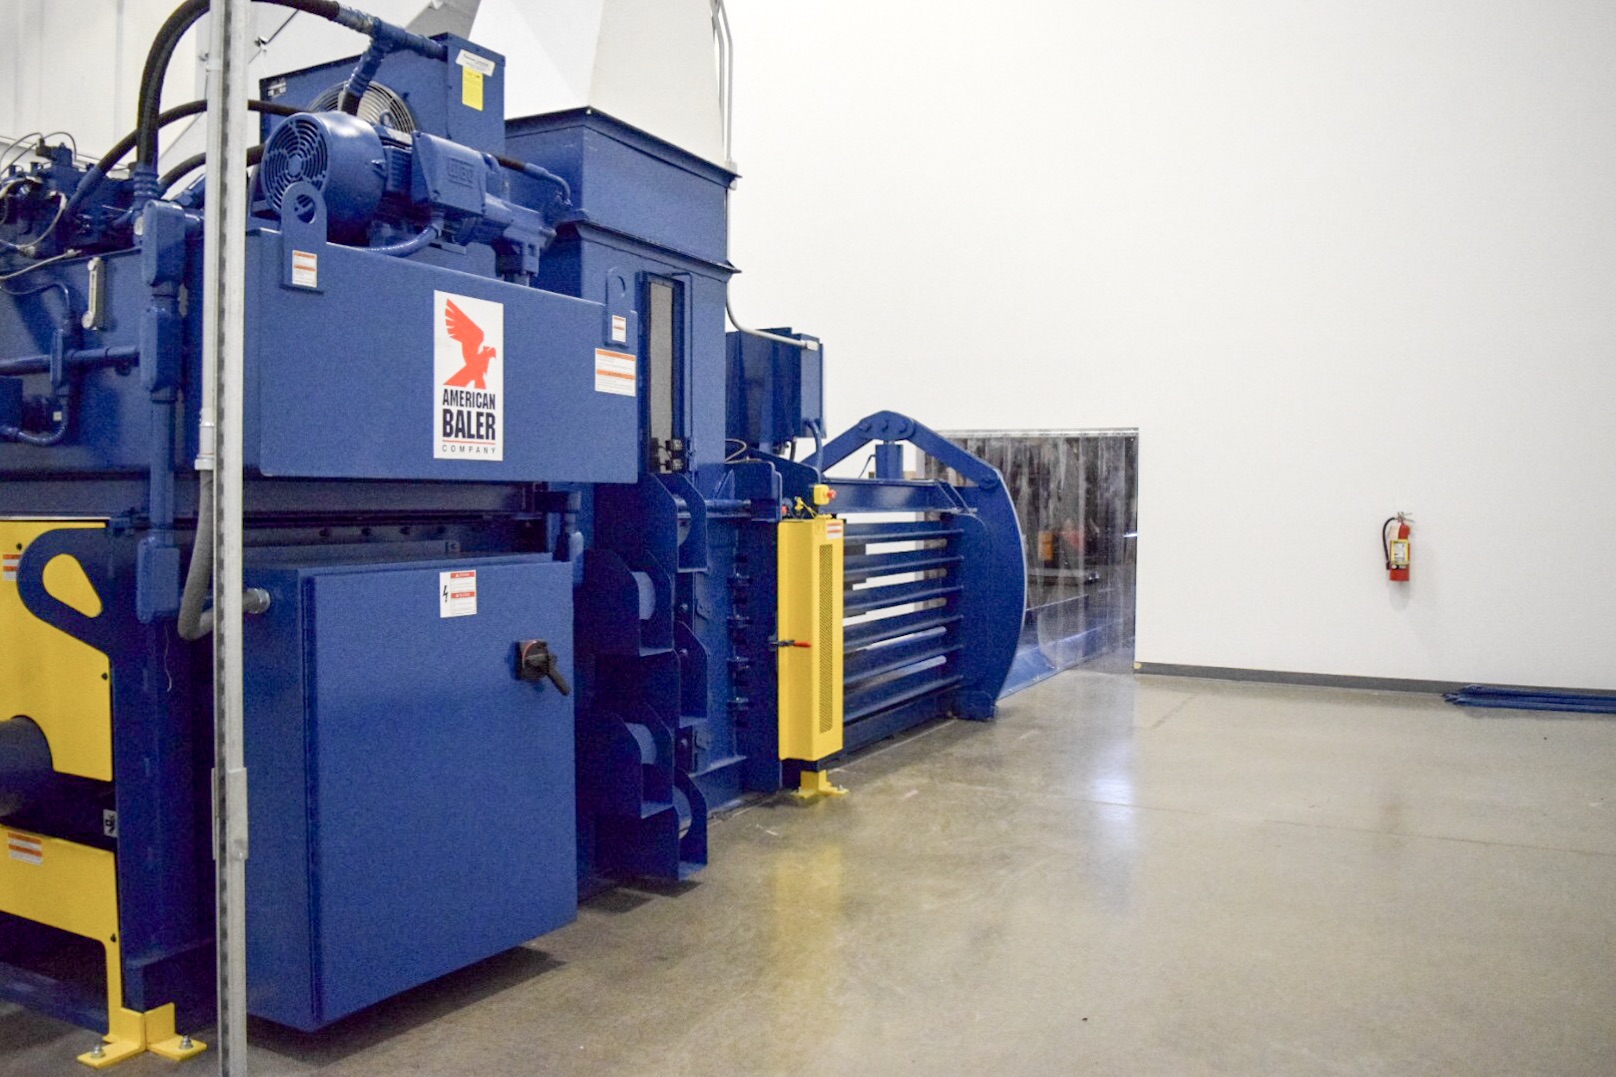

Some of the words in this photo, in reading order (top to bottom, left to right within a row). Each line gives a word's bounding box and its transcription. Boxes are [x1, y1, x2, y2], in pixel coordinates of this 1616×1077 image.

[442, 388, 496, 410] AMERICAN
[442, 408, 496, 441] BALER
[442, 445, 496, 454] COMPANY
